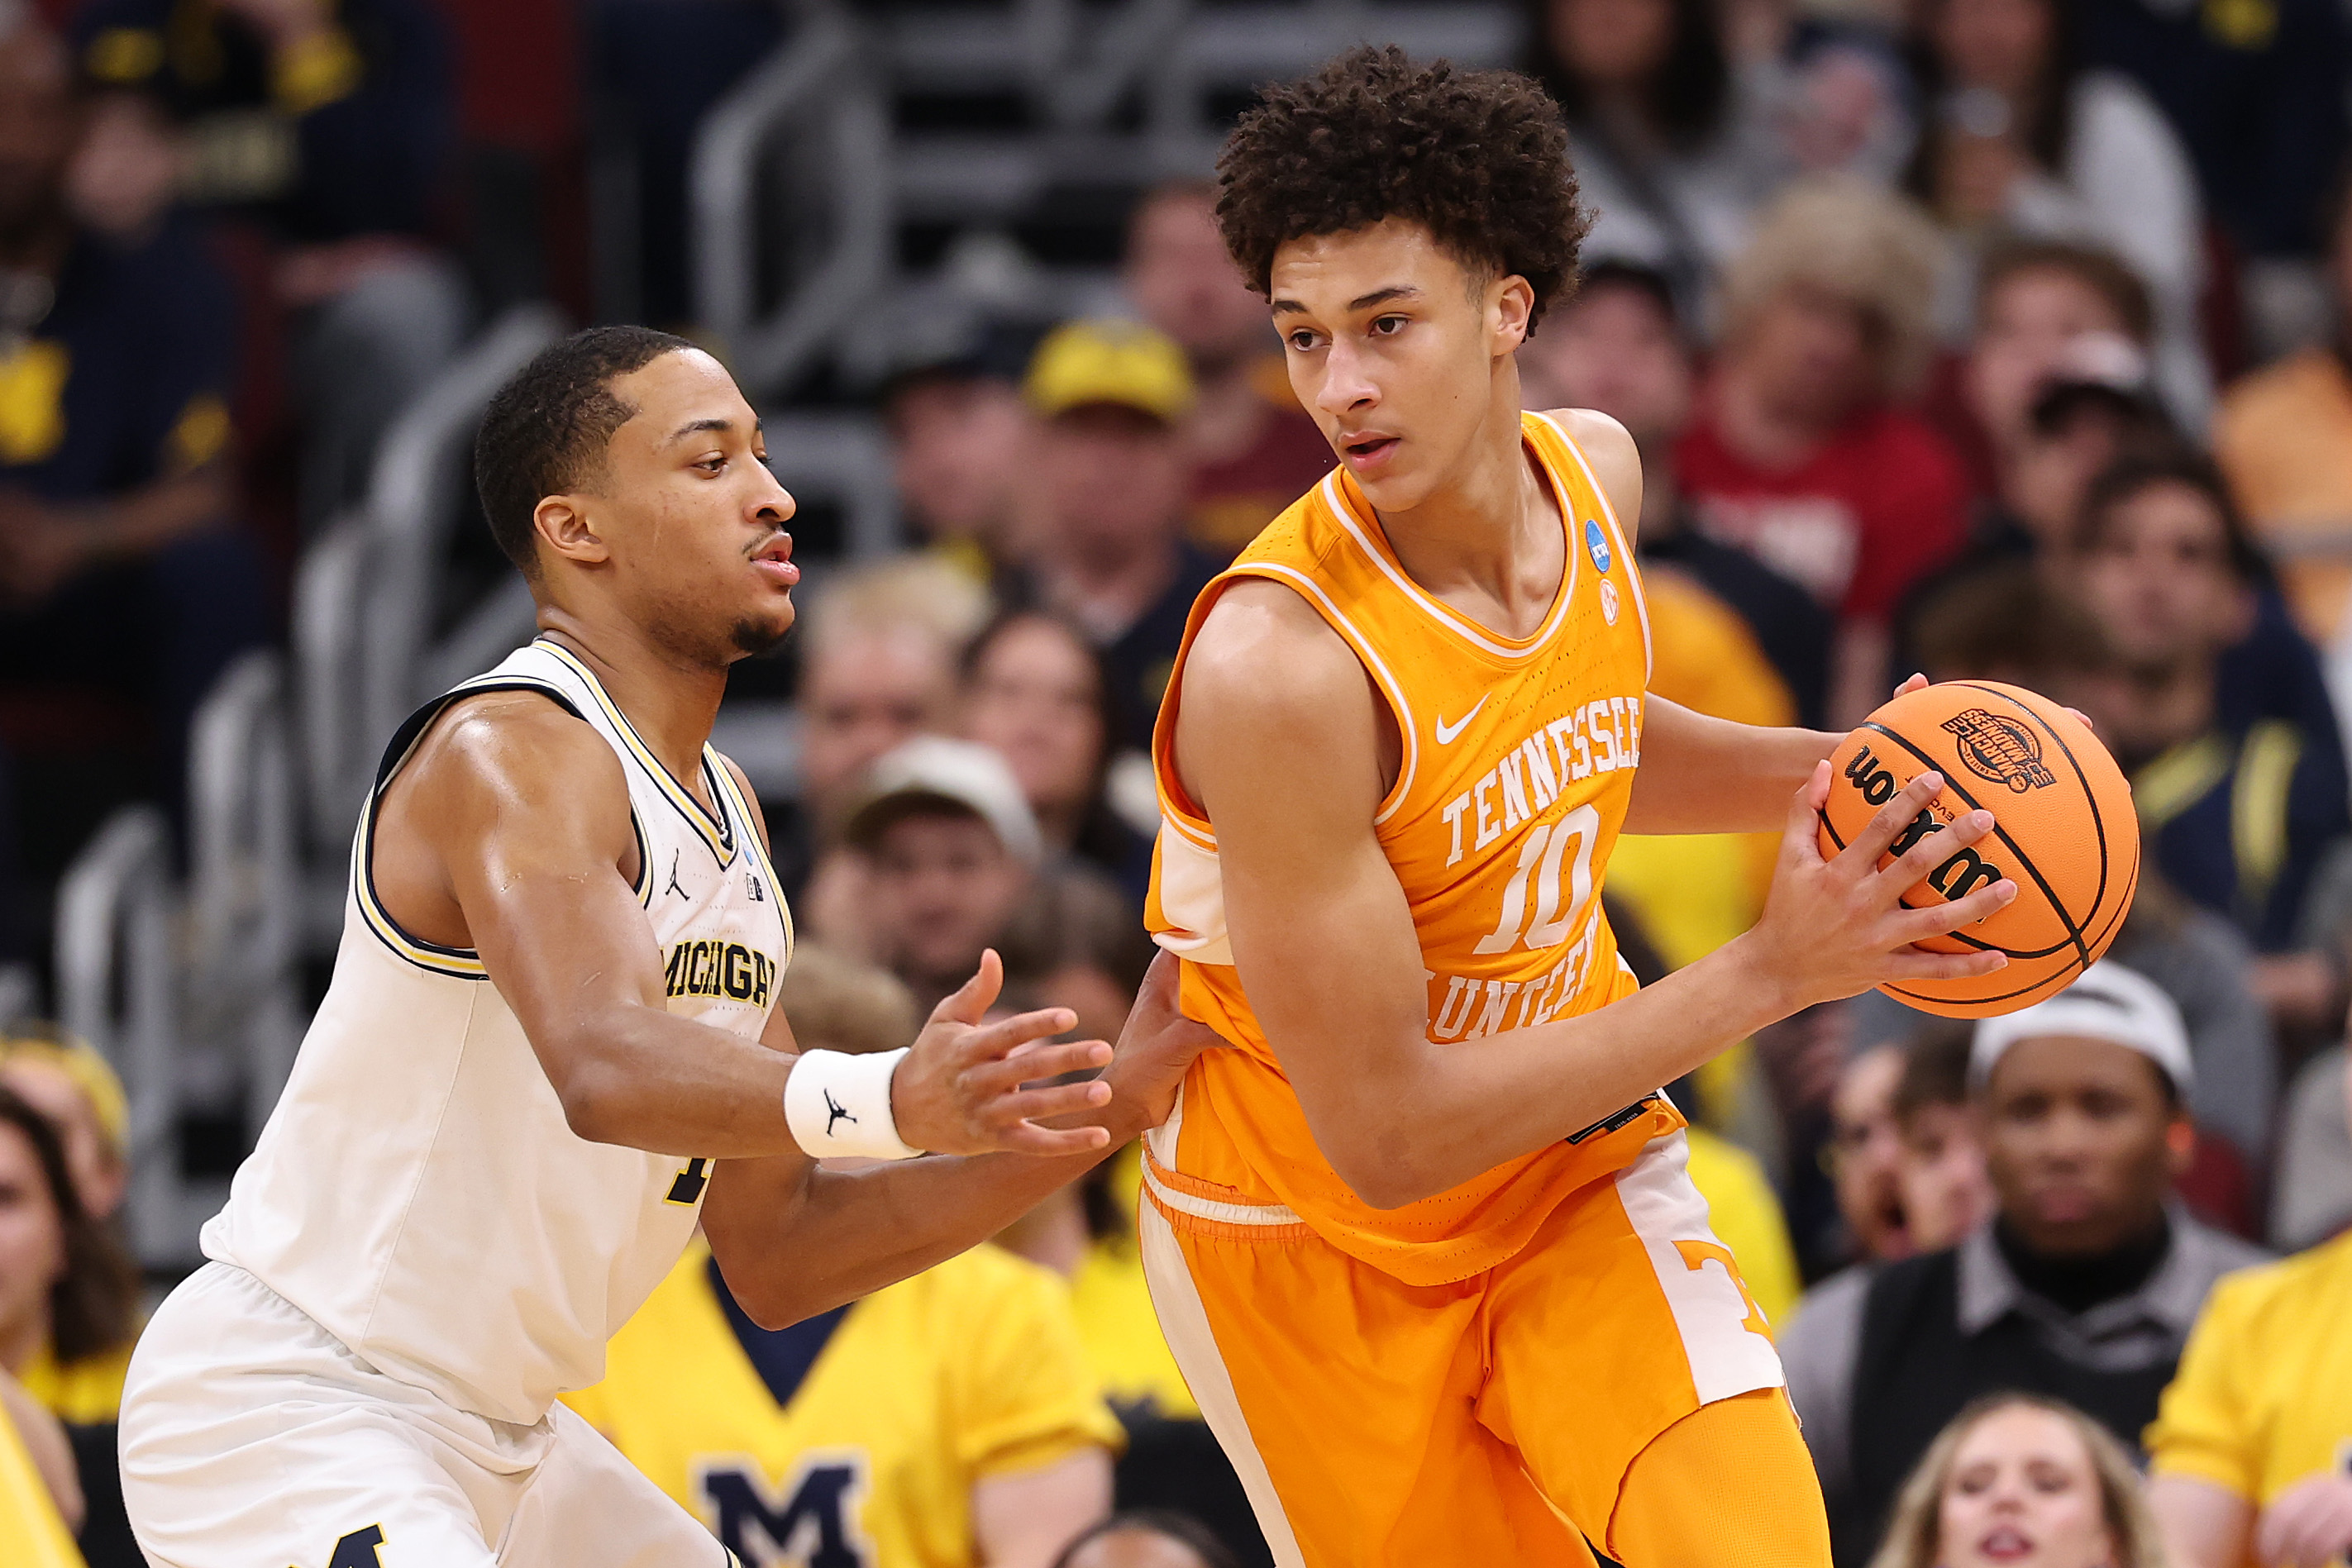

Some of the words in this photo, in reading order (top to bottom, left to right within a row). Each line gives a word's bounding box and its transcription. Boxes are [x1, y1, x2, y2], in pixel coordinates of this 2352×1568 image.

[1442, 697, 1640, 870] TENNESSEE
[1960, 709, 2028, 763] MADNESS
[1966, 732, 2020, 777] MARCH
[1472, 803, 1600, 955] 10
[703, 1461, 864, 1568] M
